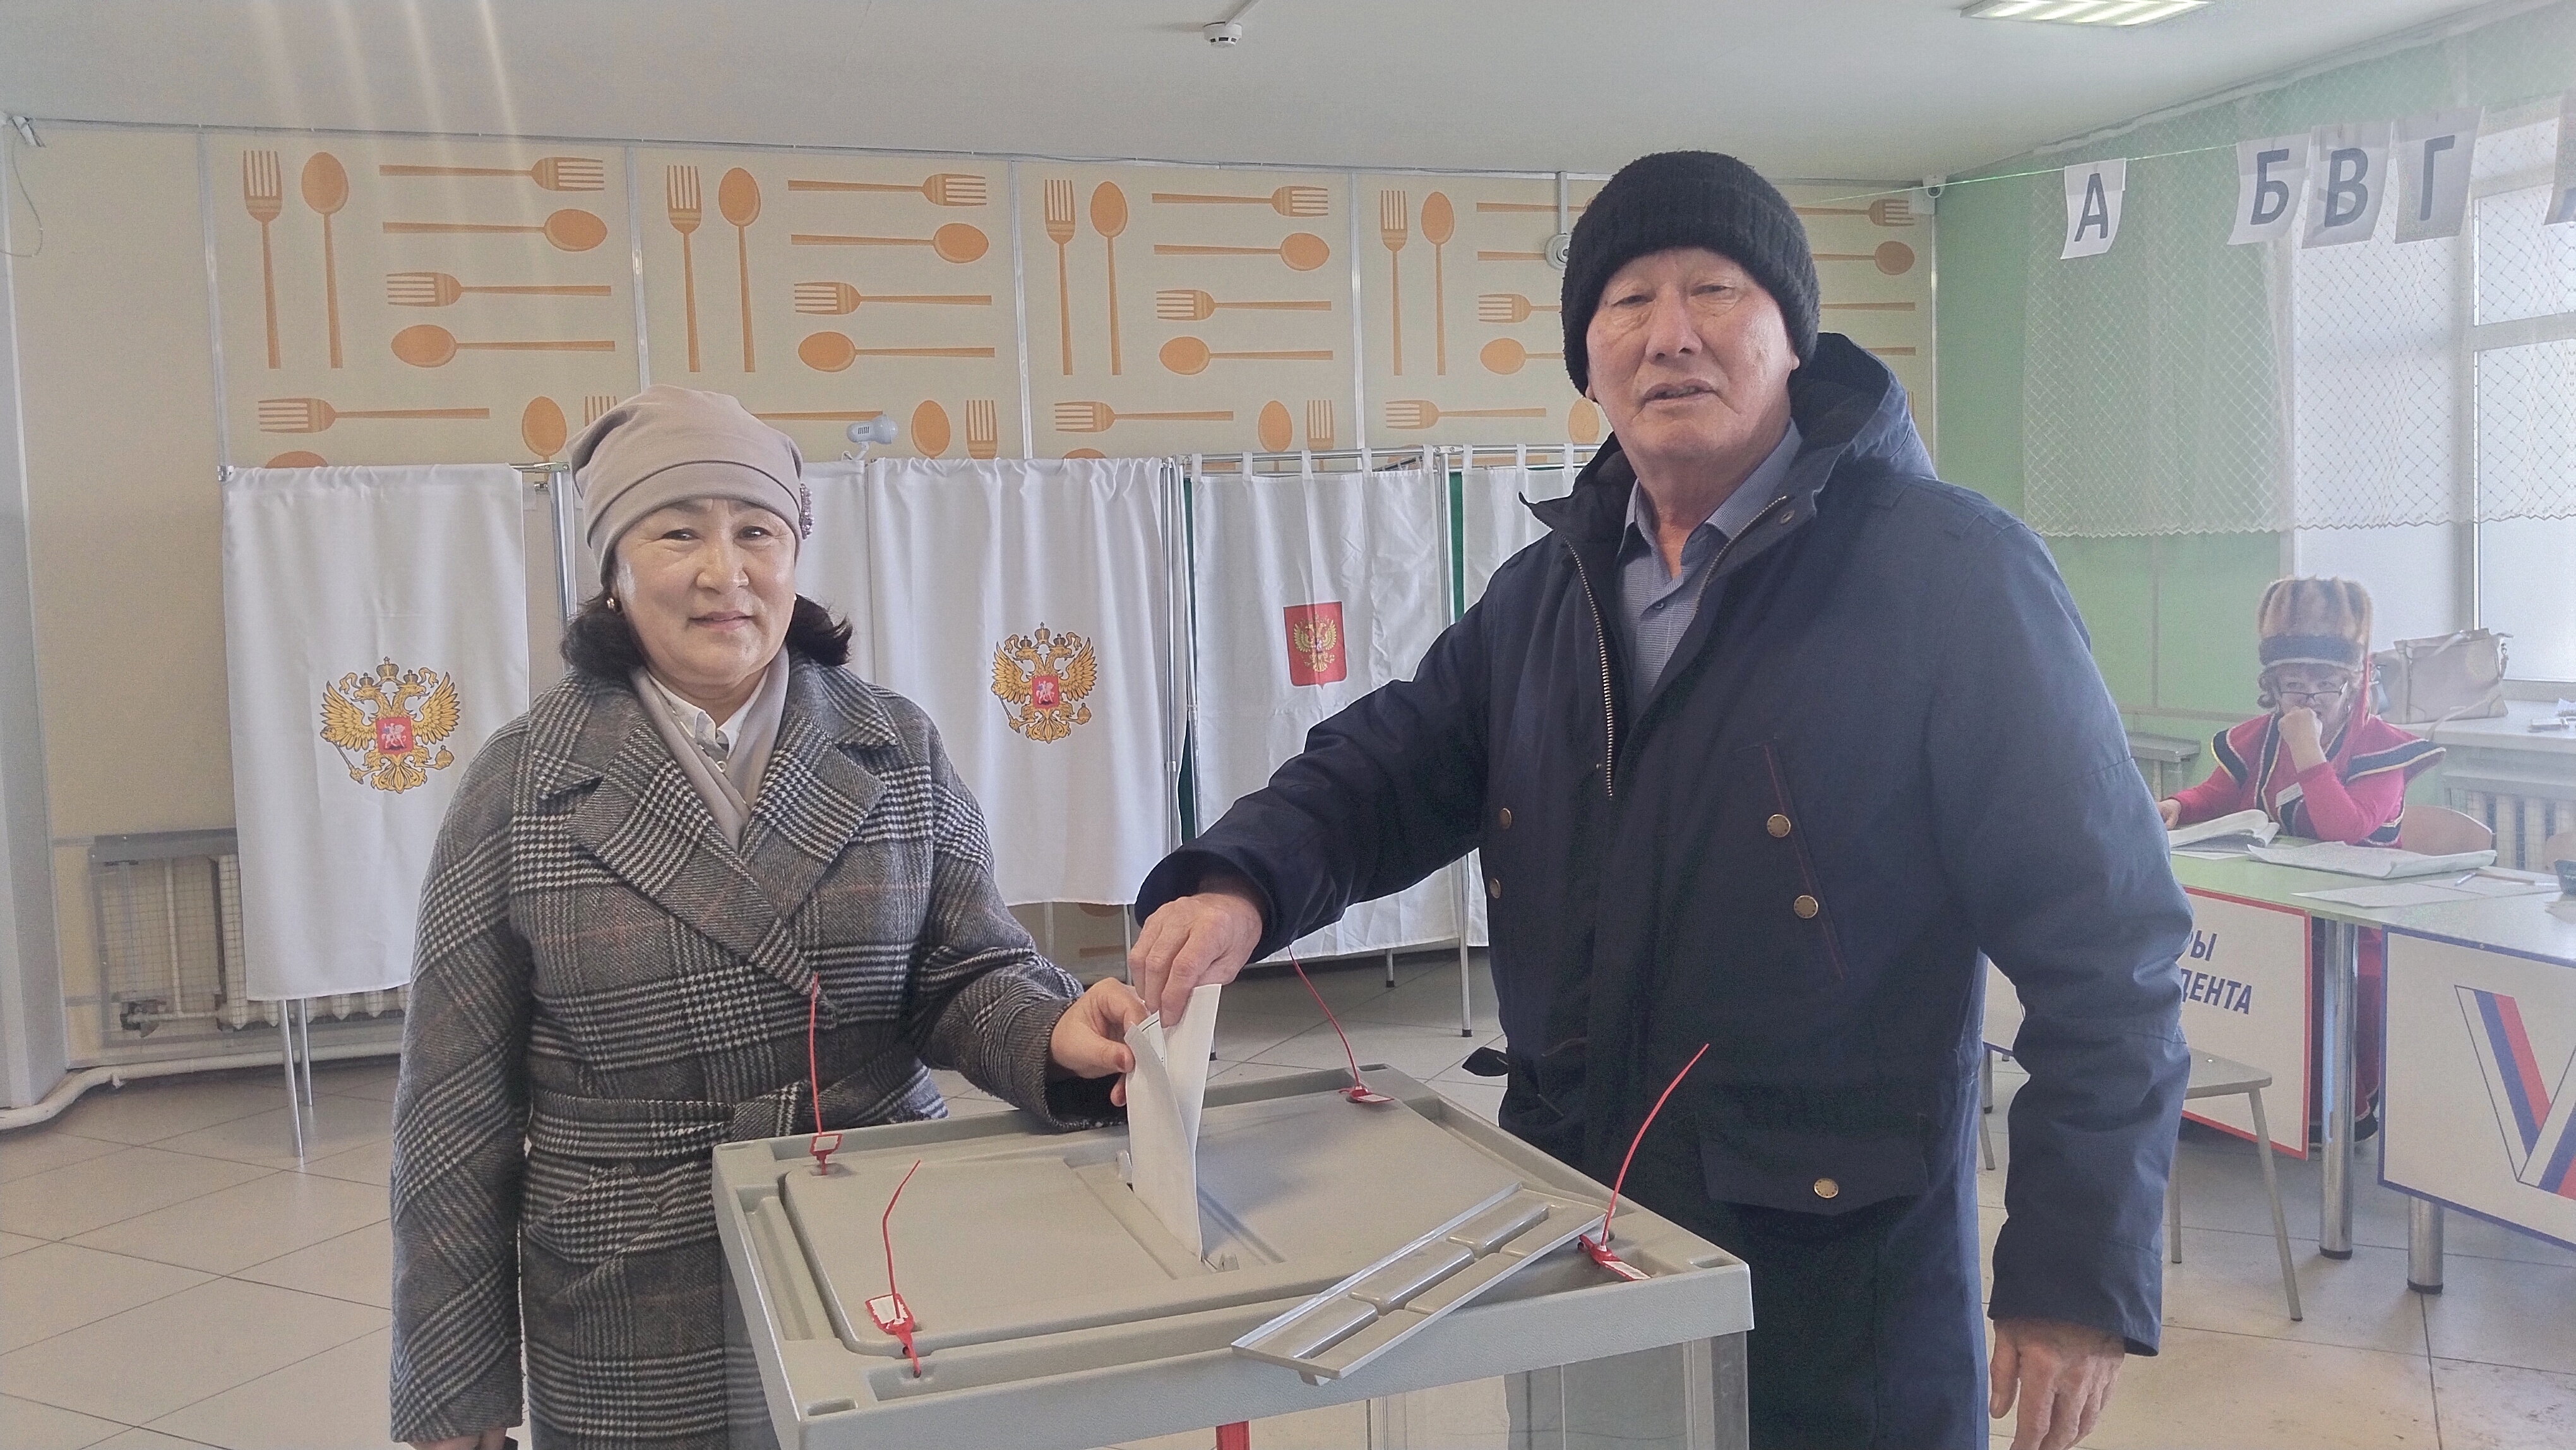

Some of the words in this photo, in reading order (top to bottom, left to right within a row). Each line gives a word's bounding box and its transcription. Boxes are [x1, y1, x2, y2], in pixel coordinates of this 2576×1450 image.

[2074, 172, 2109, 242] А
[2250, 148, 2289, 225] Б
[2324, 148, 2368, 227] В
[2419, 135, 2455, 221] Г
